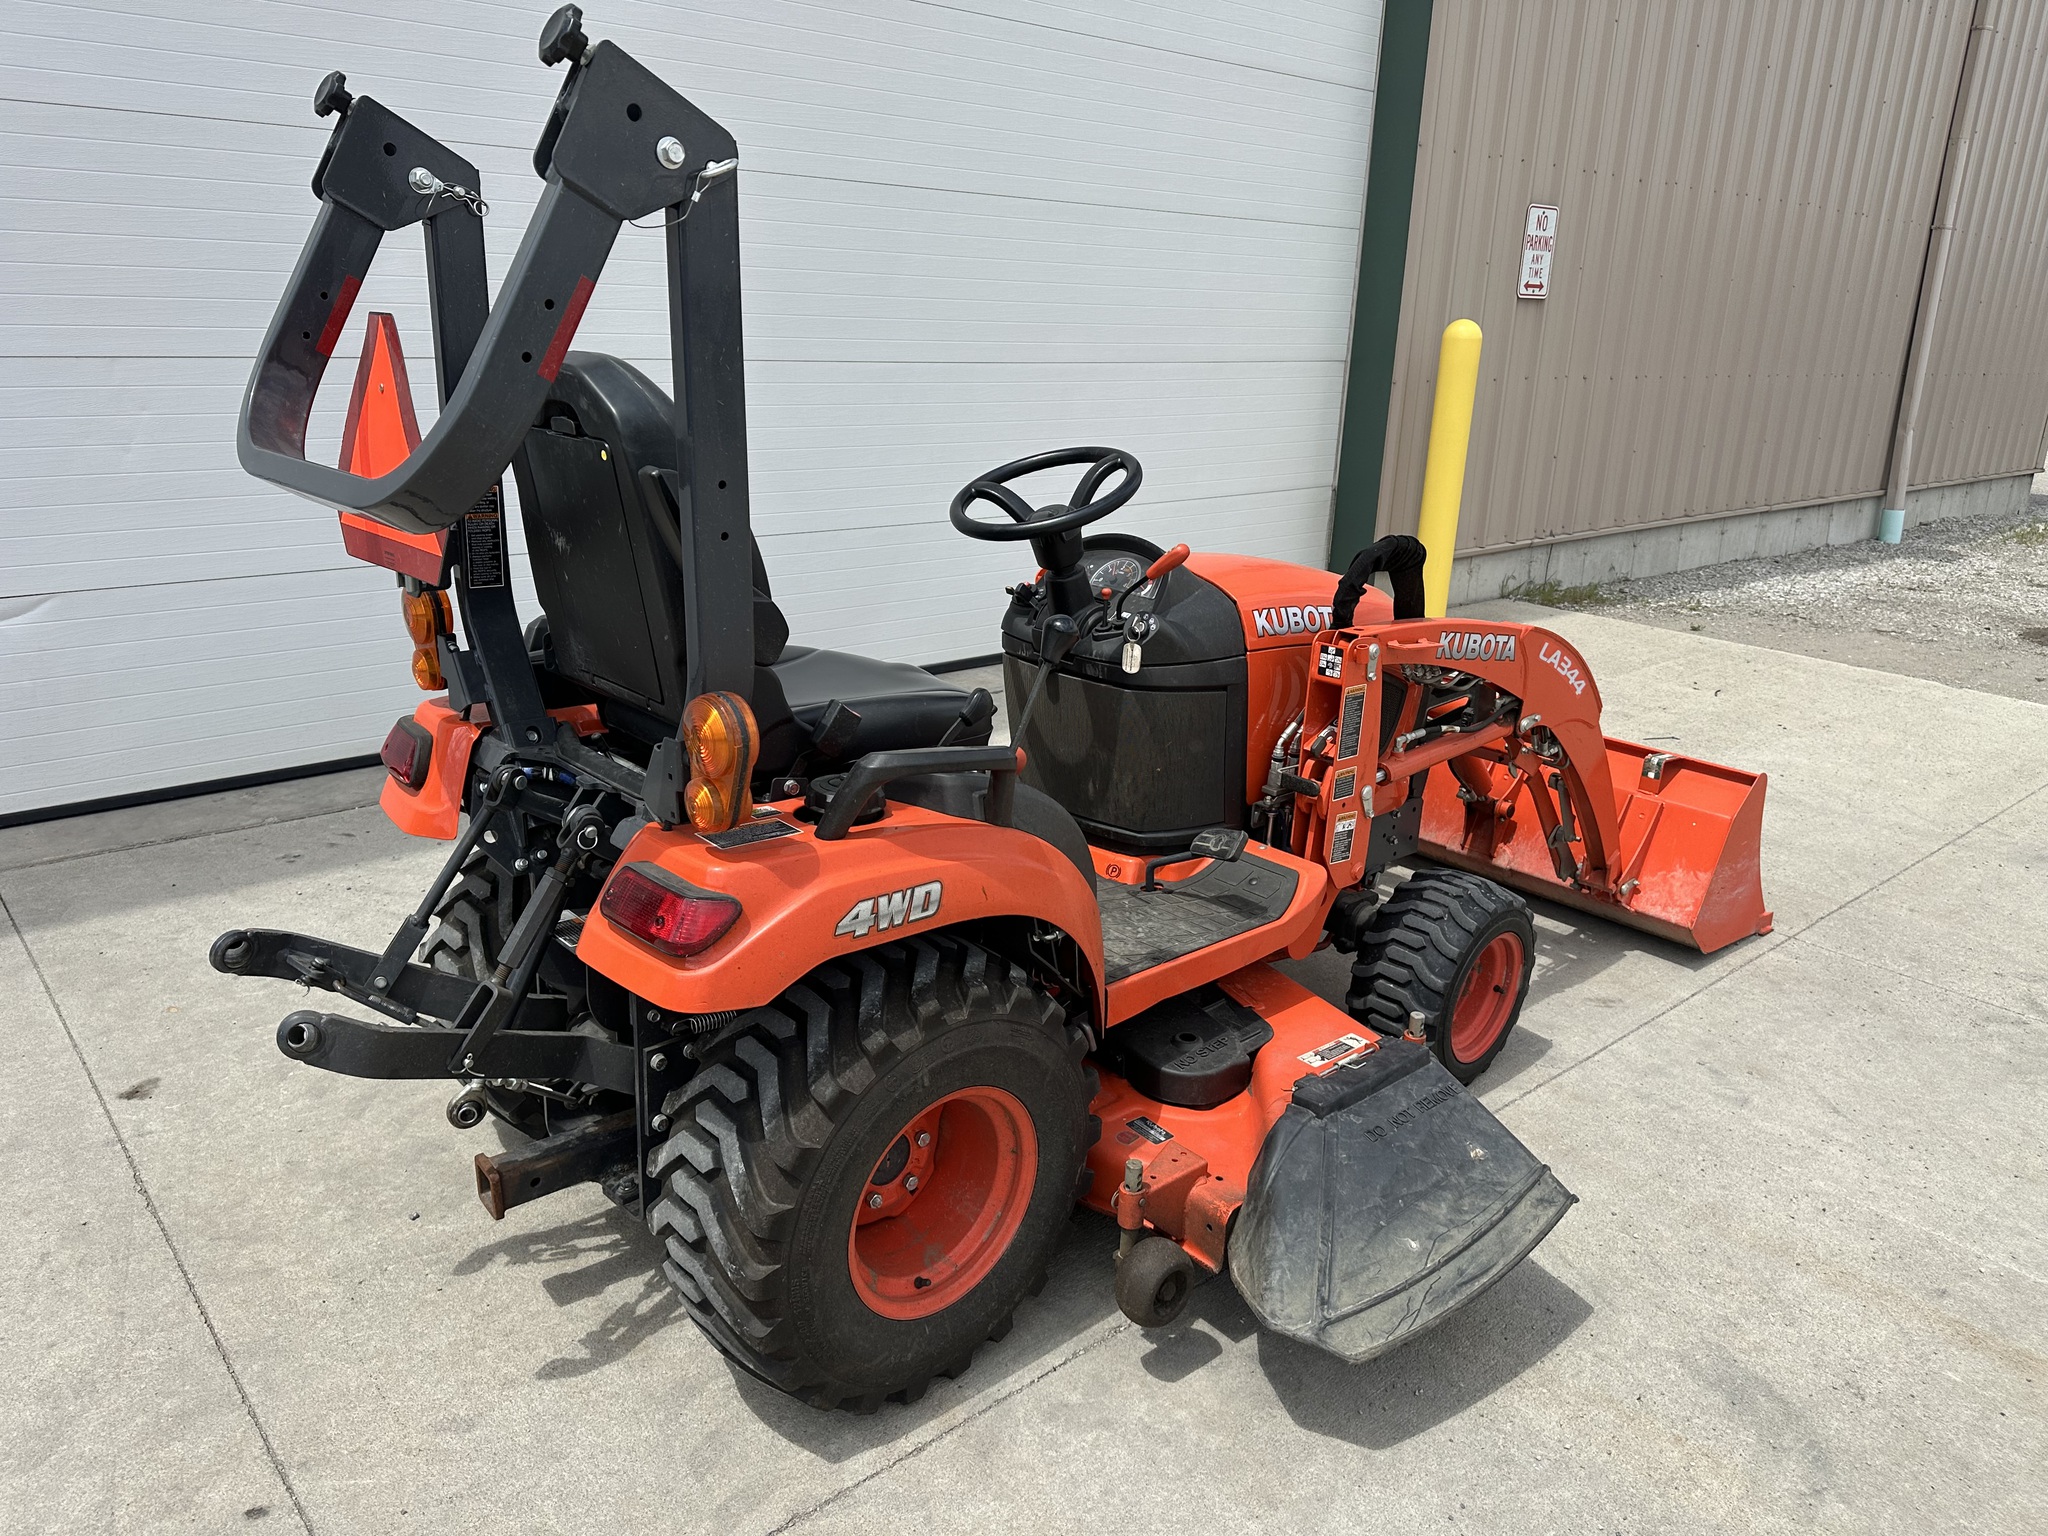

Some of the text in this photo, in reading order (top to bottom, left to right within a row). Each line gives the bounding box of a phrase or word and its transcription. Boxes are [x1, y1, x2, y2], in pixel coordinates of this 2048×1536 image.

[1536, 214, 1549, 232] NO
[1525, 234, 1554, 252] PARKING
[1528, 267, 1544, 279] TIME
[1531, 254, 1544, 265] ANY
[1252, 604, 1334, 638] KUBOT
[1435, 631, 1516, 662] KUBOTA
[1539, 642, 1586, 695] LA344
[834, 880, 943, 939] 4WD
[1173, 1037, 1228, 1070] NO STEP
[1364, 1083, 1462, 1143] DO NOT REMOVE
